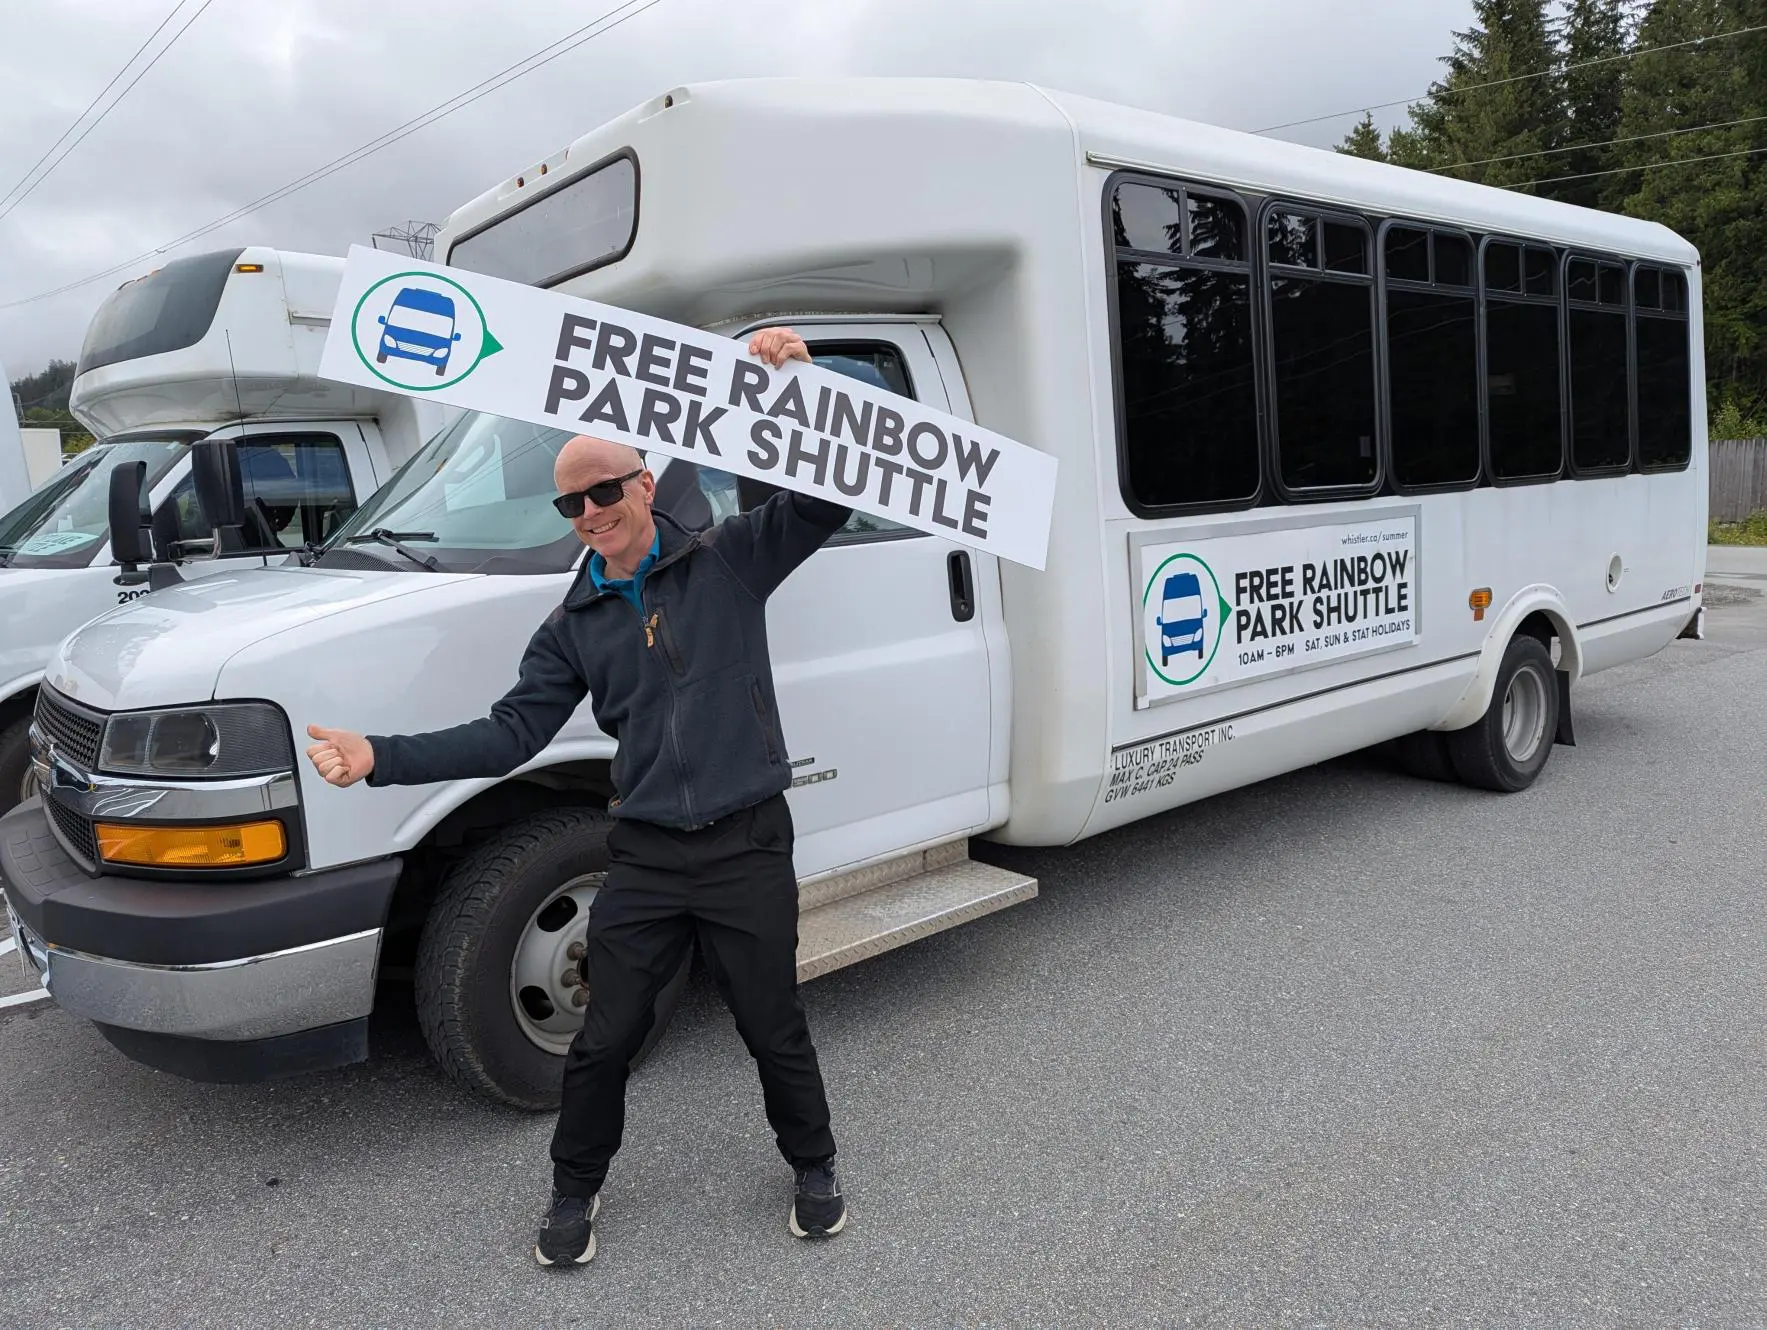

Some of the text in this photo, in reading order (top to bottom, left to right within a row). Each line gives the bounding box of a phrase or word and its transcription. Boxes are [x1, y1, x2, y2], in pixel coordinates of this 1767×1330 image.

[555, 312, 1000, 489] FREE RAINBOW
[544, 364, 991, 540] PARK SHUTTLE
[1341, 531, 1408, 546] whistler.ca/summer
[1235, 549, 1409, 606] FREE RAINBOW
[1236, 582, 1409, 644] PARK SHUTTLE
[1238, 649, 1264, 666] 10AM
[1275, 643, 1295, 658] 6PM
[1305, 638, 1322, 652] SAT,
[1324, 632, 1341, 648] SUN
[1343, 633, 1350, 644] &
[1352, 627, 1370, 642] STAT
[1371, 619, 1411, 637] HOLIDAYS
[1110, 769, 1134, 787] MAX
[1180, 749, 1204, 769] PASS
[1115, 725, 1236, 771] LUXURY TRANSPORT INC.
[792, 769, 838, 788] 500
[1105, 782, 1132, 803] GVW
[1155, 771, 1176, 789] KGS
